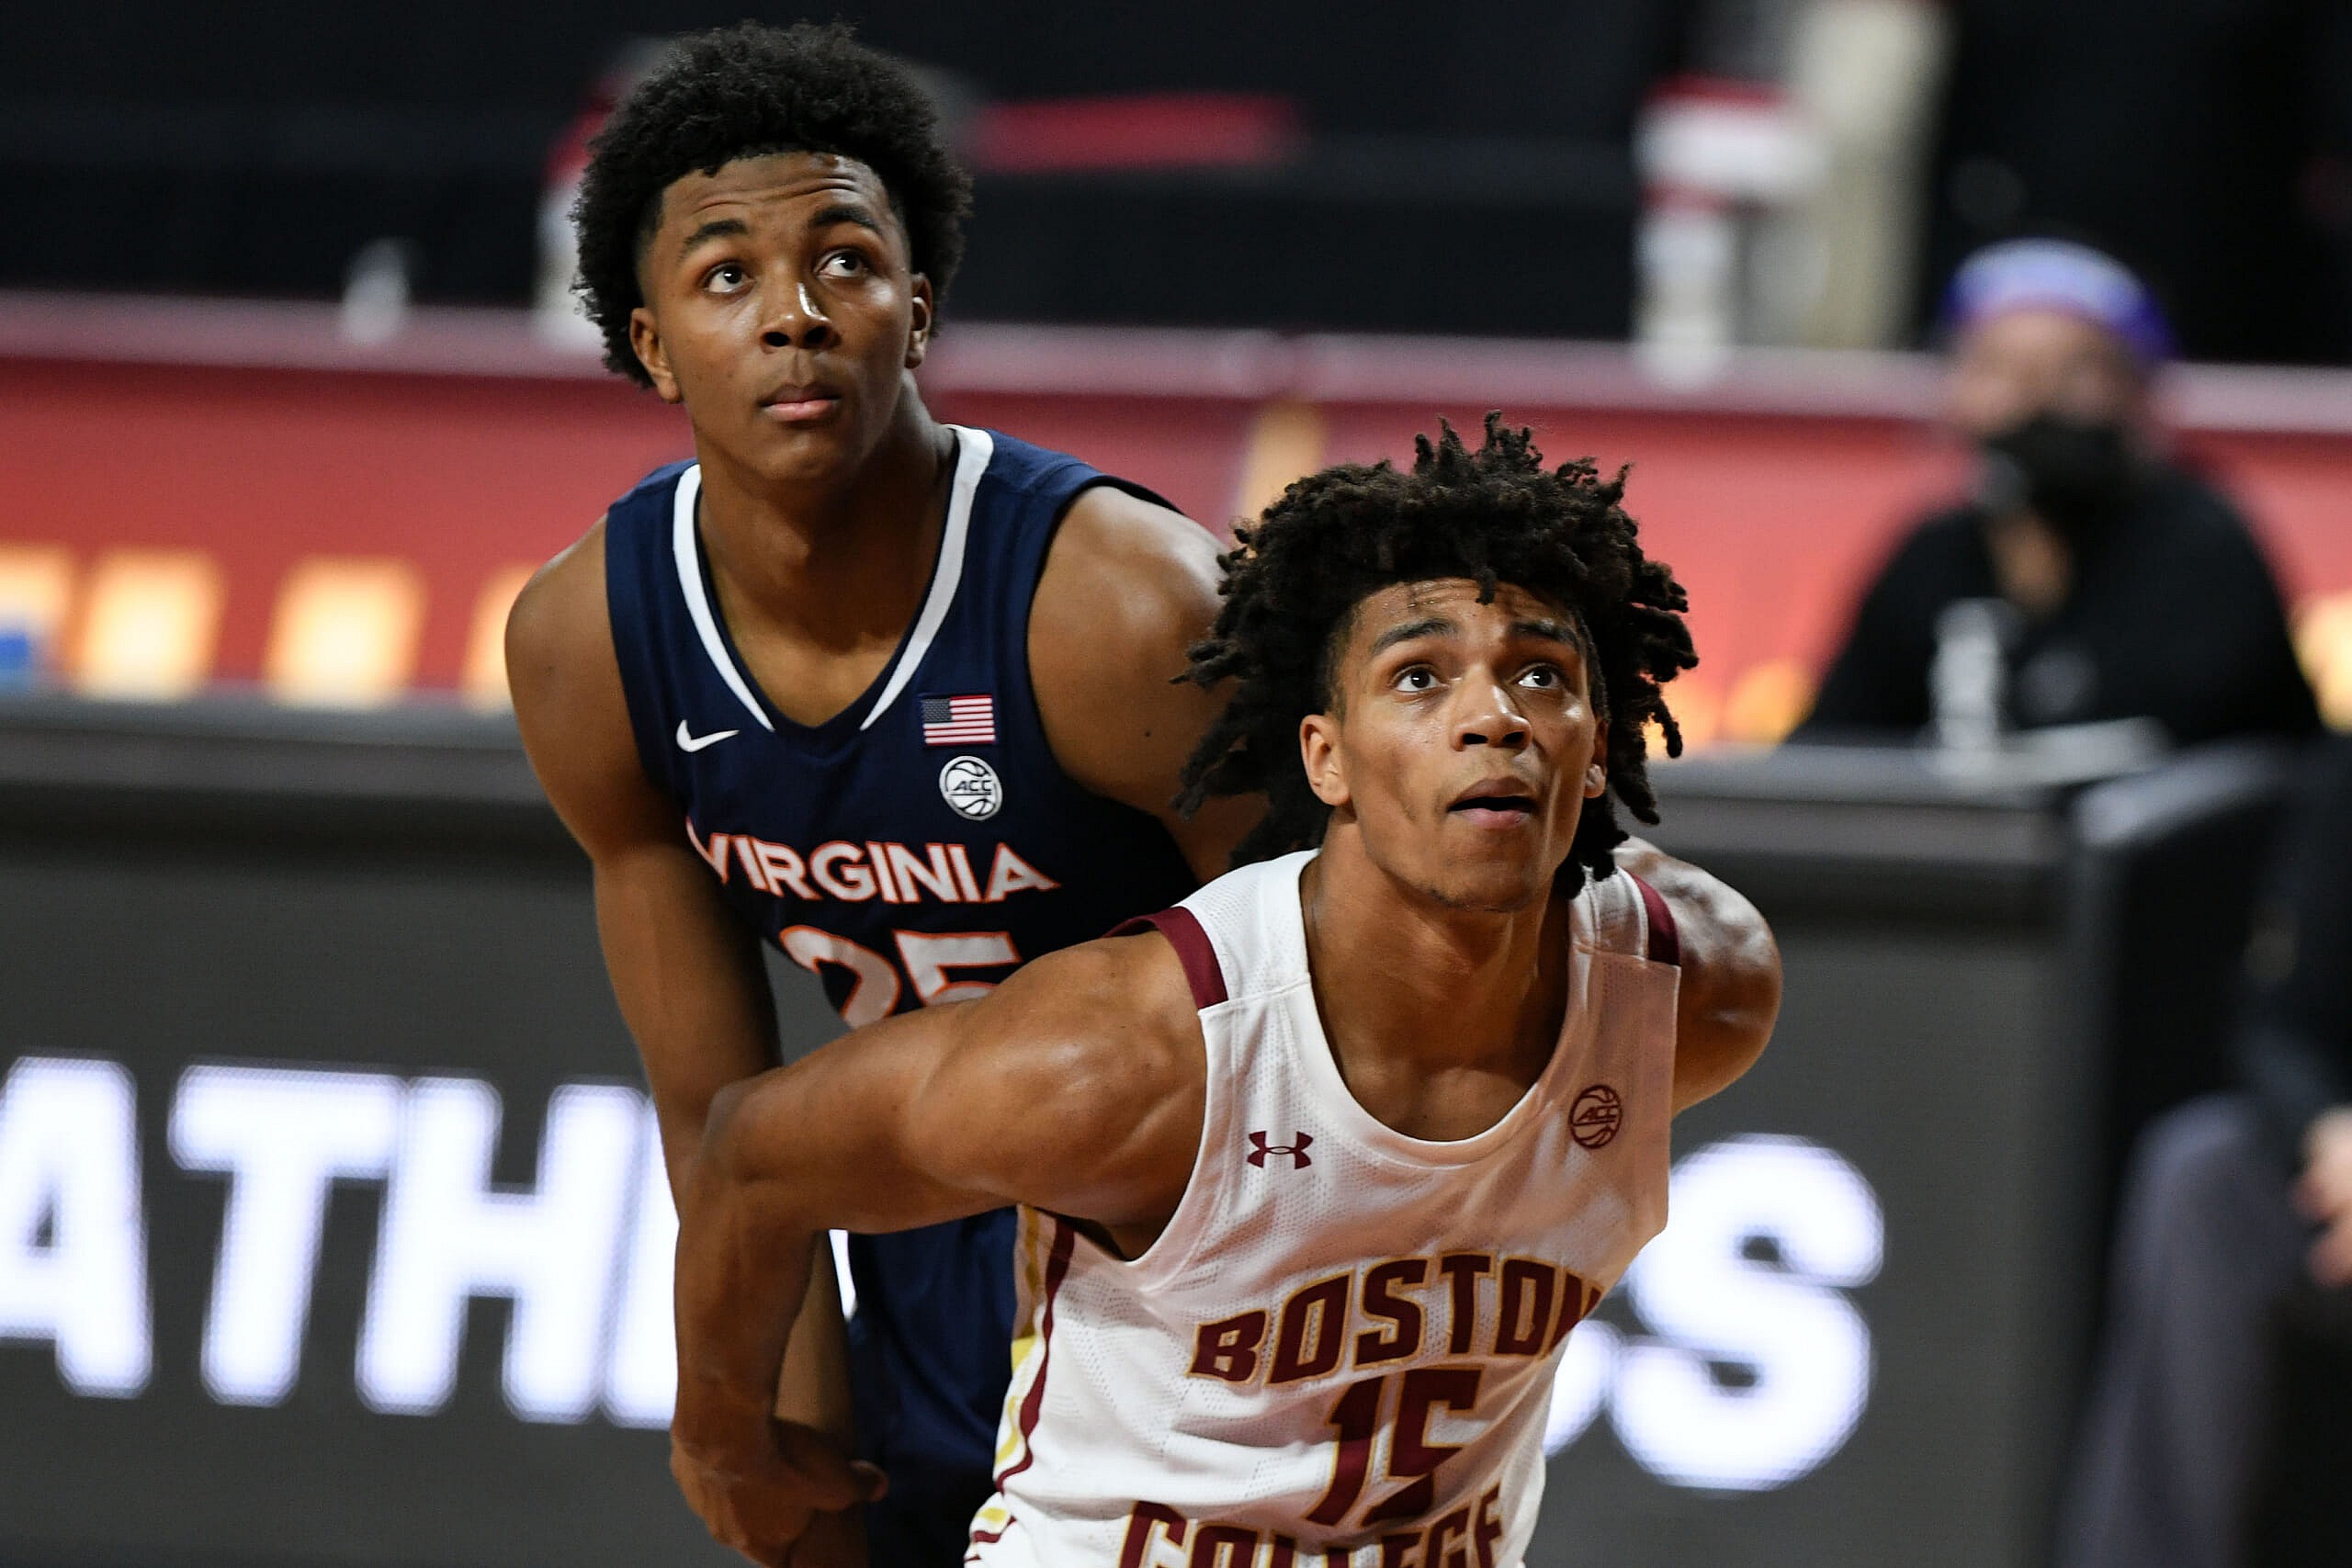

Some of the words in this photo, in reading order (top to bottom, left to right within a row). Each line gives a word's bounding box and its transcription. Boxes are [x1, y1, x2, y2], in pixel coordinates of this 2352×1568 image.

[953, 779, 993, 792] ACC
[685, 815, 1060, 904] VIRGINIA
[778, 924, 1023, 1027] 25
[1575, 1104, 1620, 1122] ACC
[1306, 1364, 1485, 1529] 15
